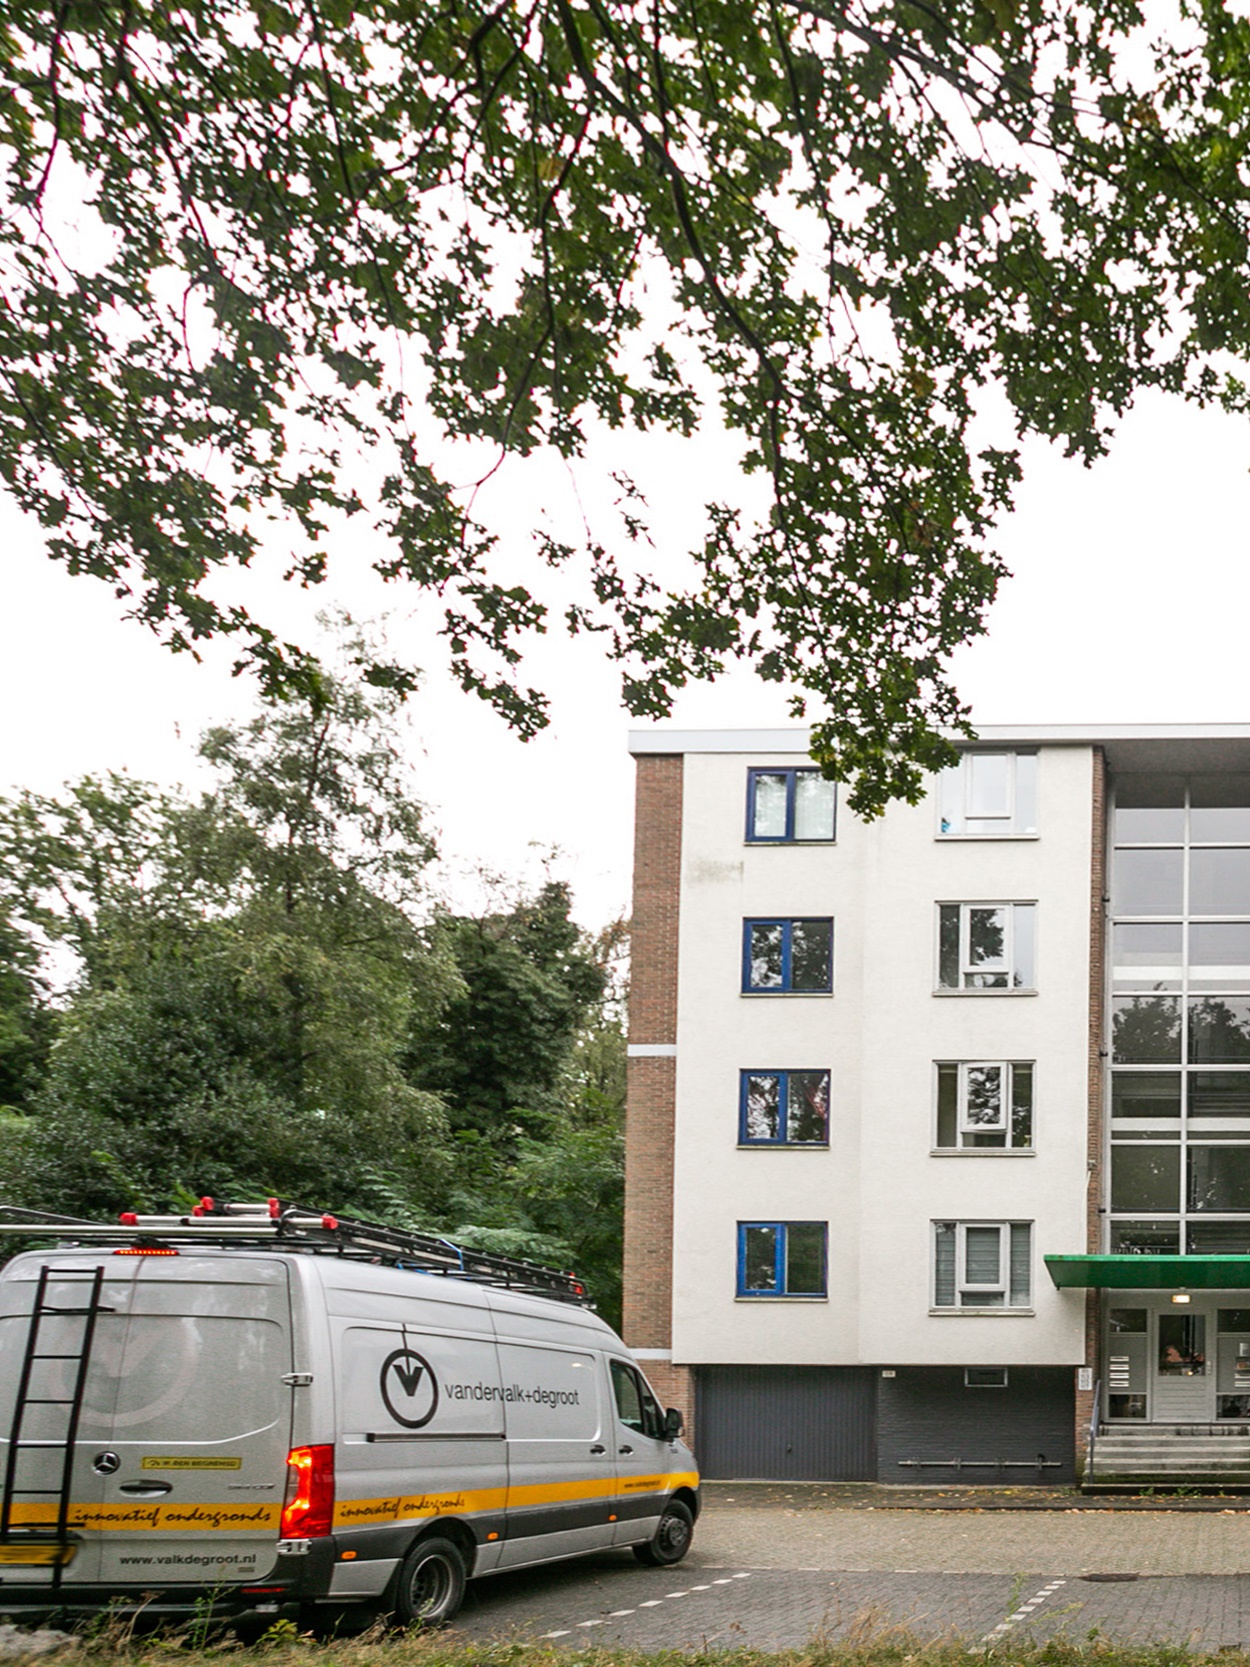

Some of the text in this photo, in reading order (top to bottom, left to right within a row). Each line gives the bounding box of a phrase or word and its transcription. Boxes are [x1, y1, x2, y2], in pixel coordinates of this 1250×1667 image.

[444, 1381, 580, 1409] vandervalk+degroot
[75, 1507, 271, 1527] innovatief ondergronds
[119, 1554, 256, 1566] www.valkdegroot.nl
